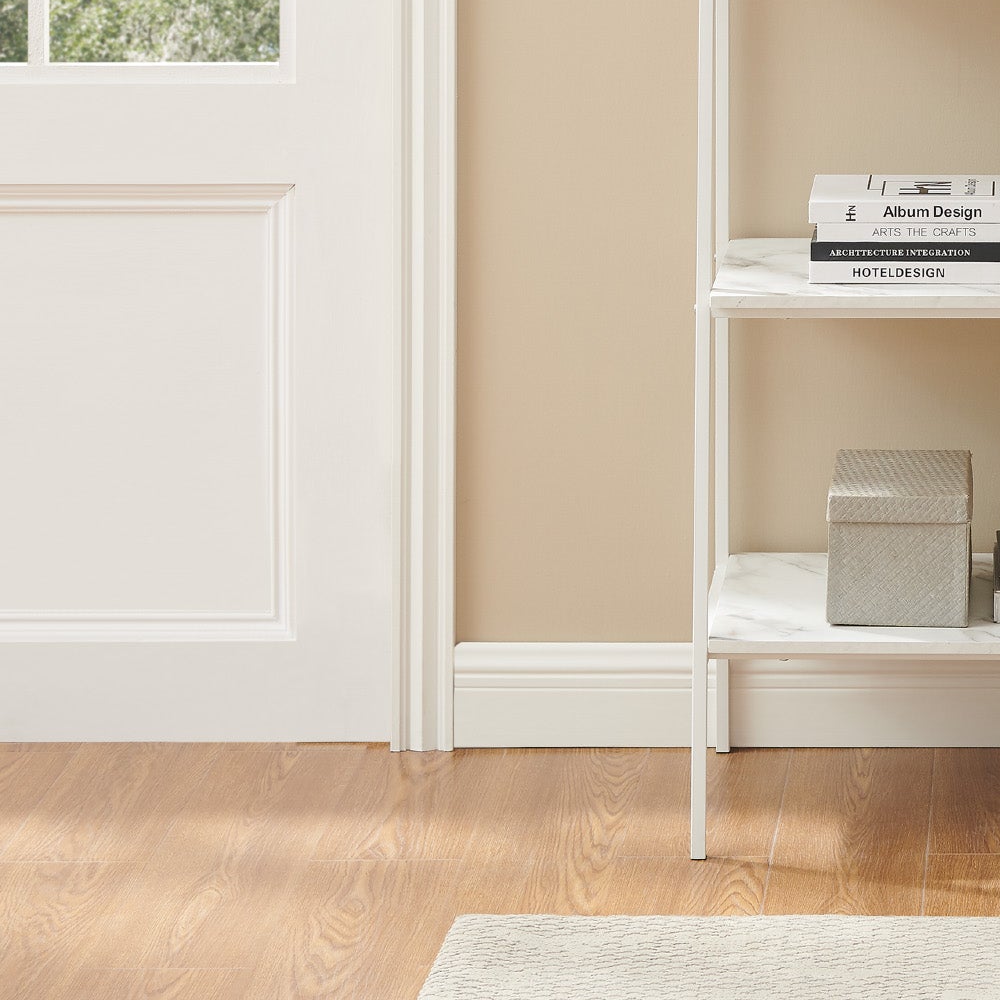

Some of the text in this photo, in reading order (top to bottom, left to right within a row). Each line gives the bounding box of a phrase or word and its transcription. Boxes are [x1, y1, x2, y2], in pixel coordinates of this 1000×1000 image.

[883, 205, 982, 221] Album Design
[872, 228, 976, 237] ARTS THE CRAFTS
[906, 249, 971, 257] INTEGRATION
[852, 267, 945, 278] HOTELDESIGN
